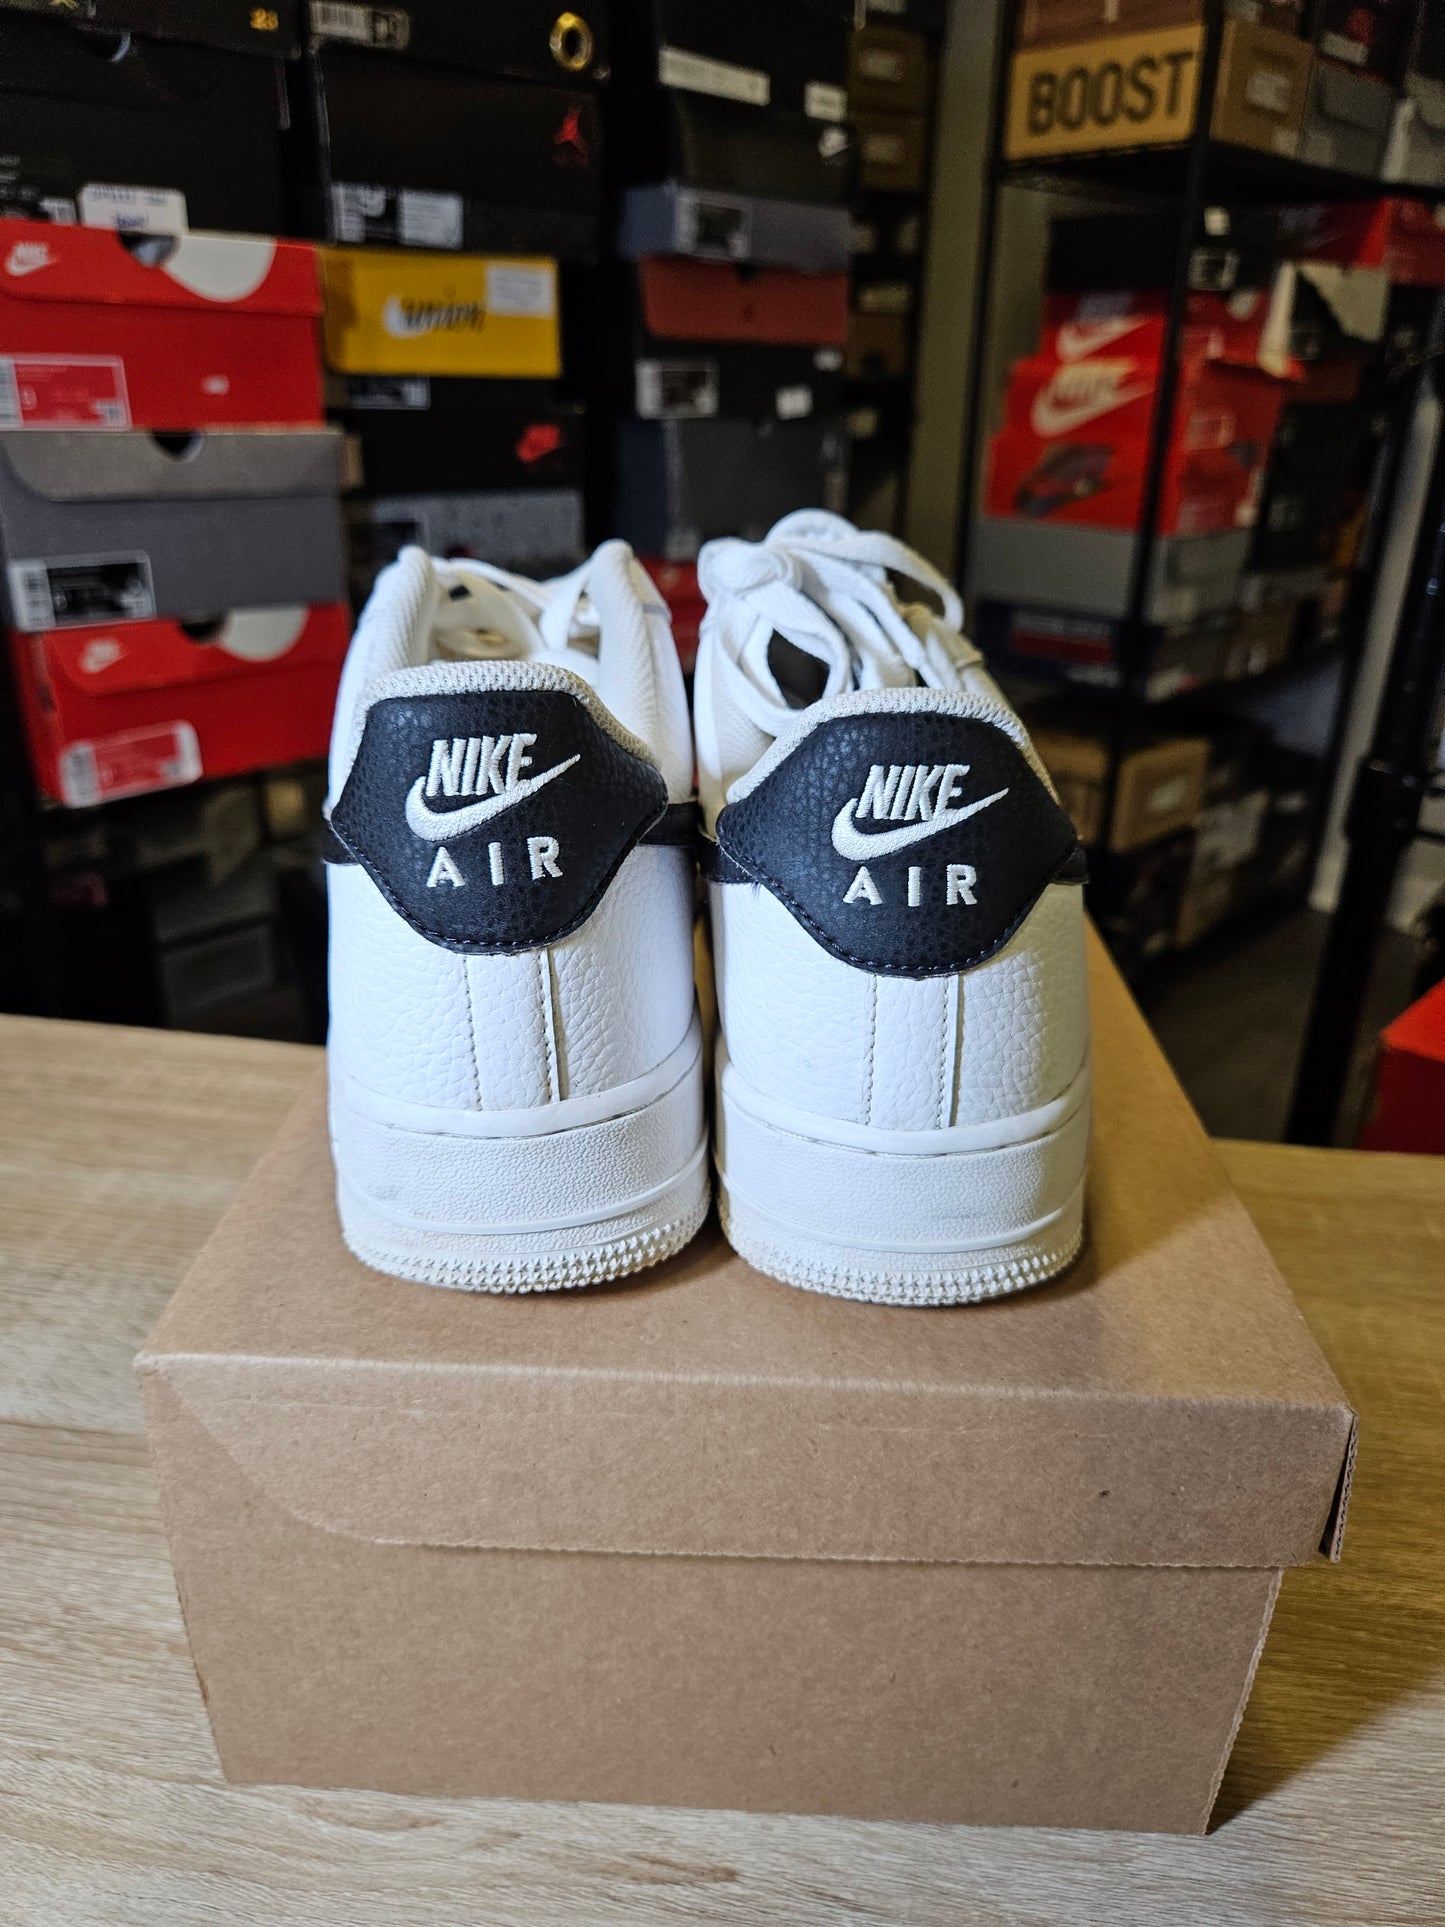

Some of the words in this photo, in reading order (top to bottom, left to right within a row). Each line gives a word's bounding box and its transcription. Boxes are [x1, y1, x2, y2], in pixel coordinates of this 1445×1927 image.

[1028, 50, 1195, 138] BOOST
[425, 733, 538, 796] NIKE
[855, 764, 970, 821] NIKE
[426, 836, 563, 888] AIR
[842, 863, 977, 907] AIR
